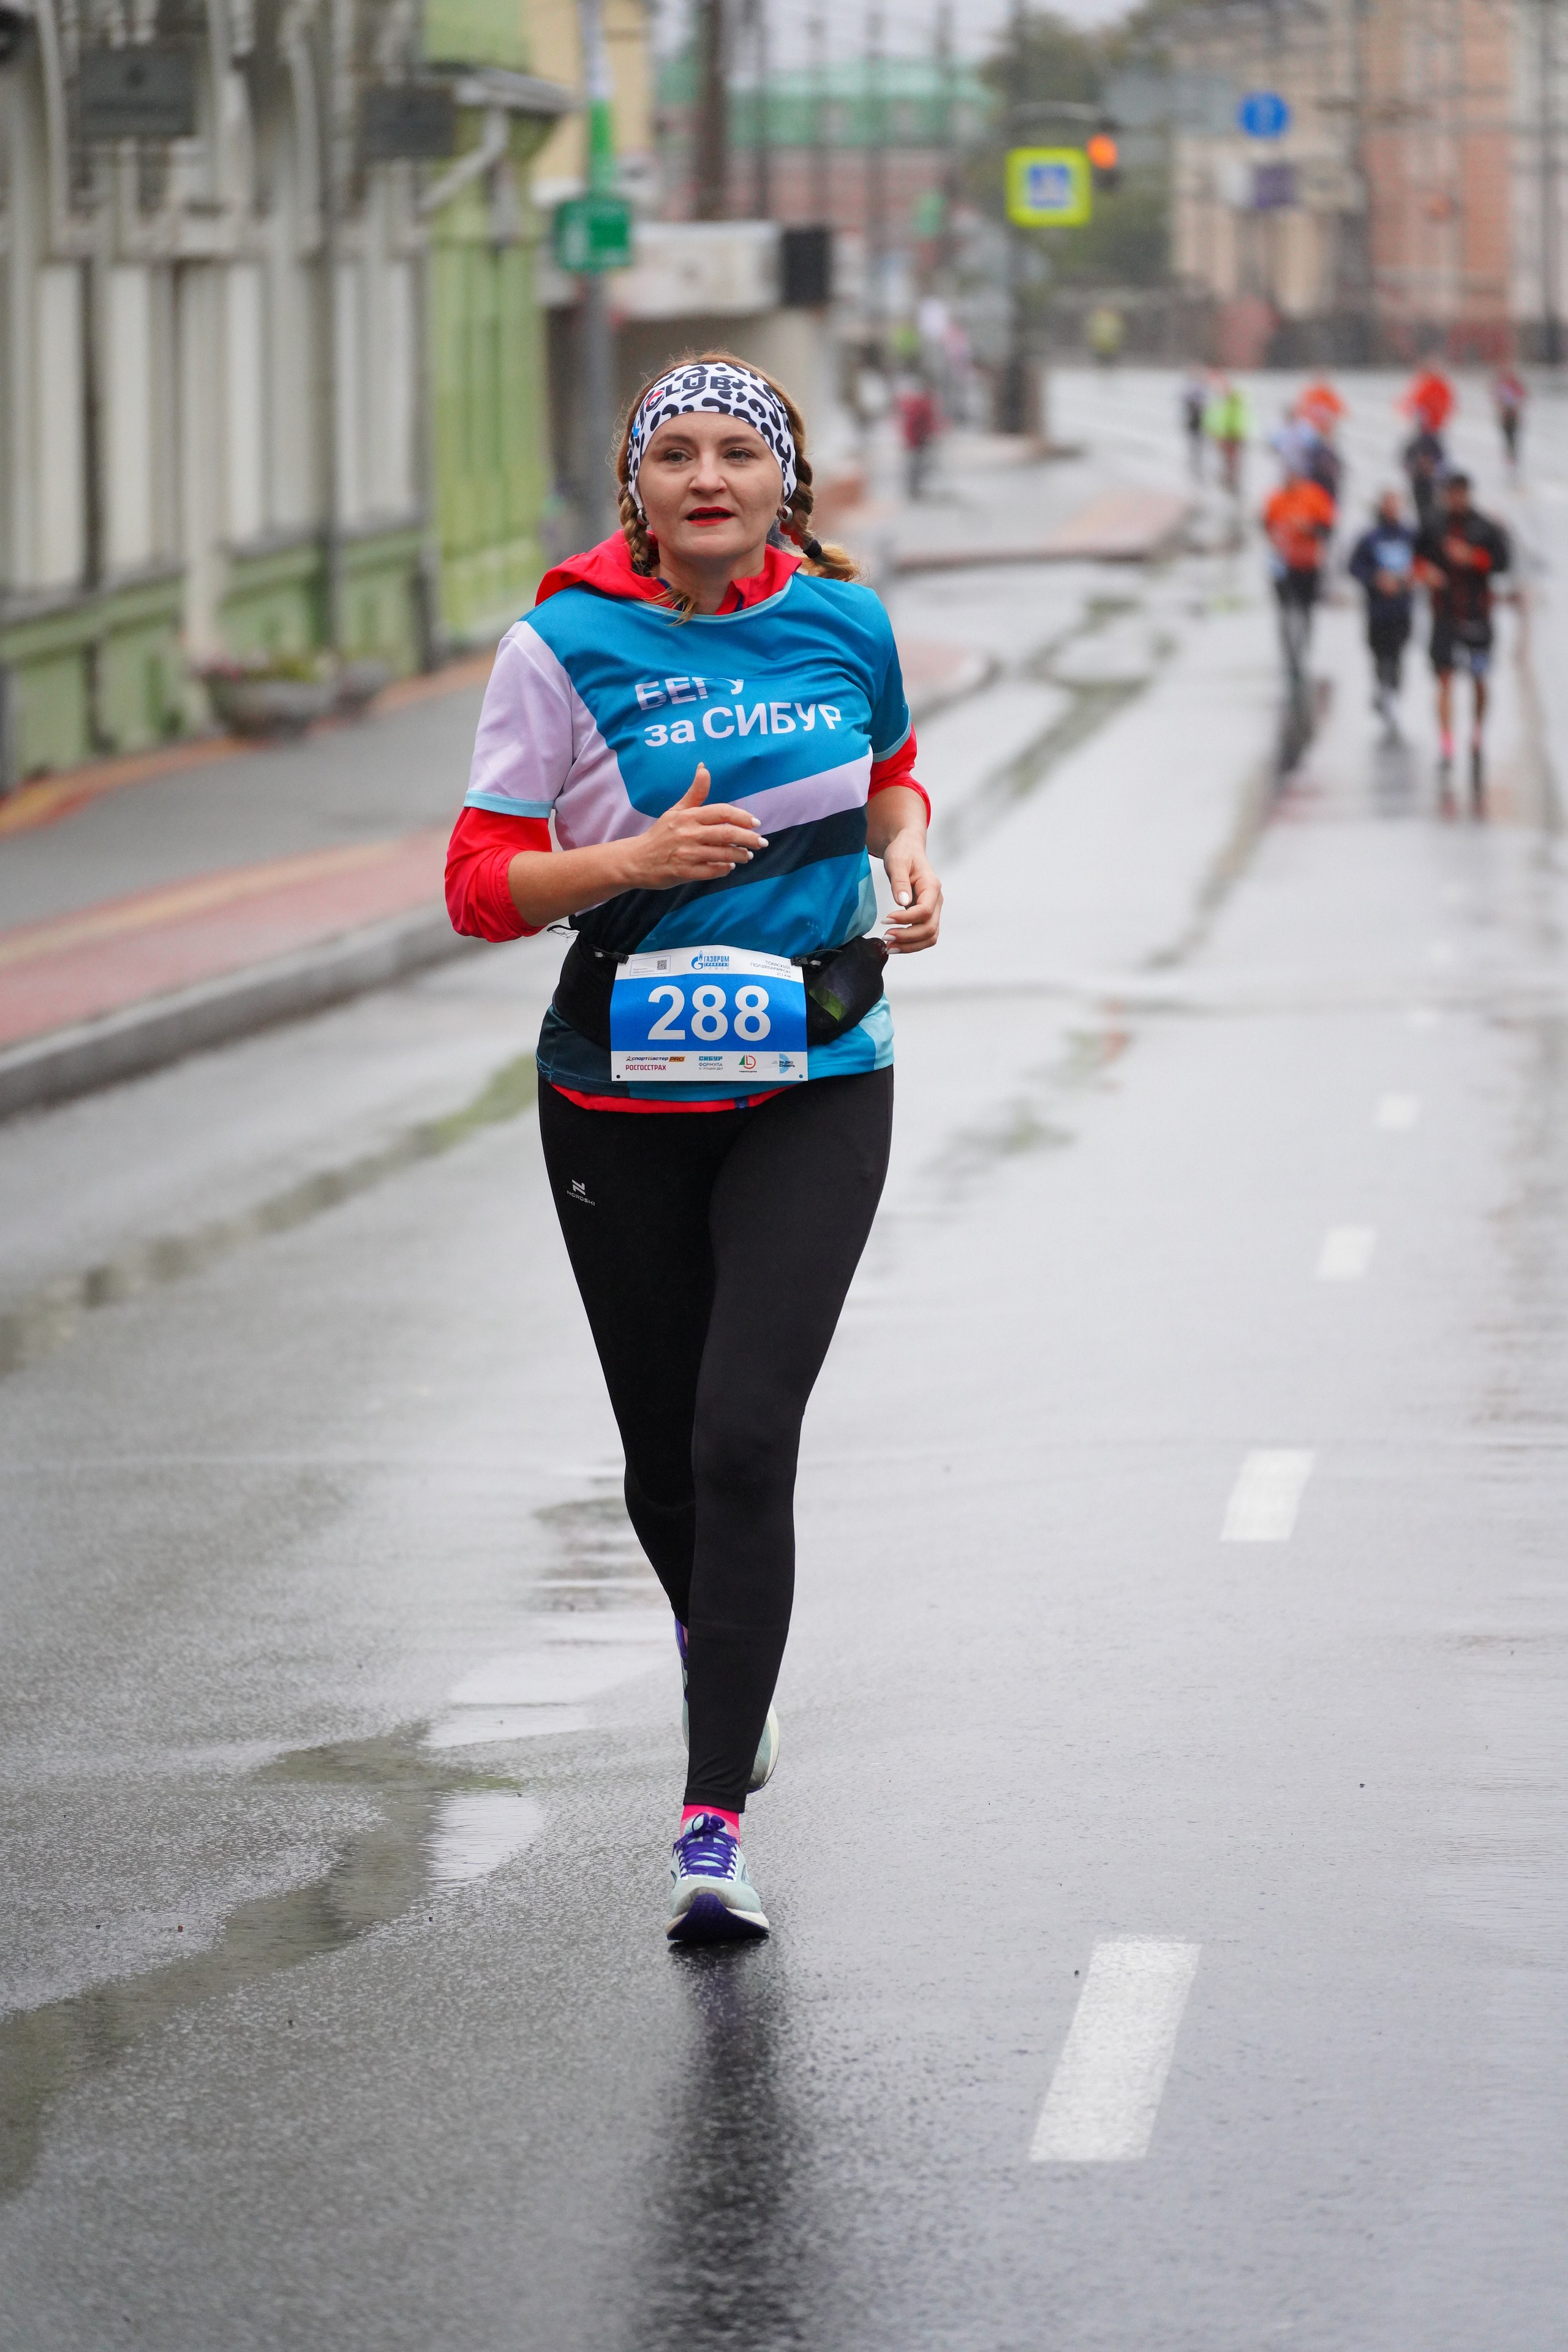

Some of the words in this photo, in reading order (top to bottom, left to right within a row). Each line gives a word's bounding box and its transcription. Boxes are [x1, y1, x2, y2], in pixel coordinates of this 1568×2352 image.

[644, 720, 696, 747] за
[703, 702, 842, 739] СИБУР
[647, 985, 771, 1041] 288
[567, 1190, 595, 1206] NORDSKI
